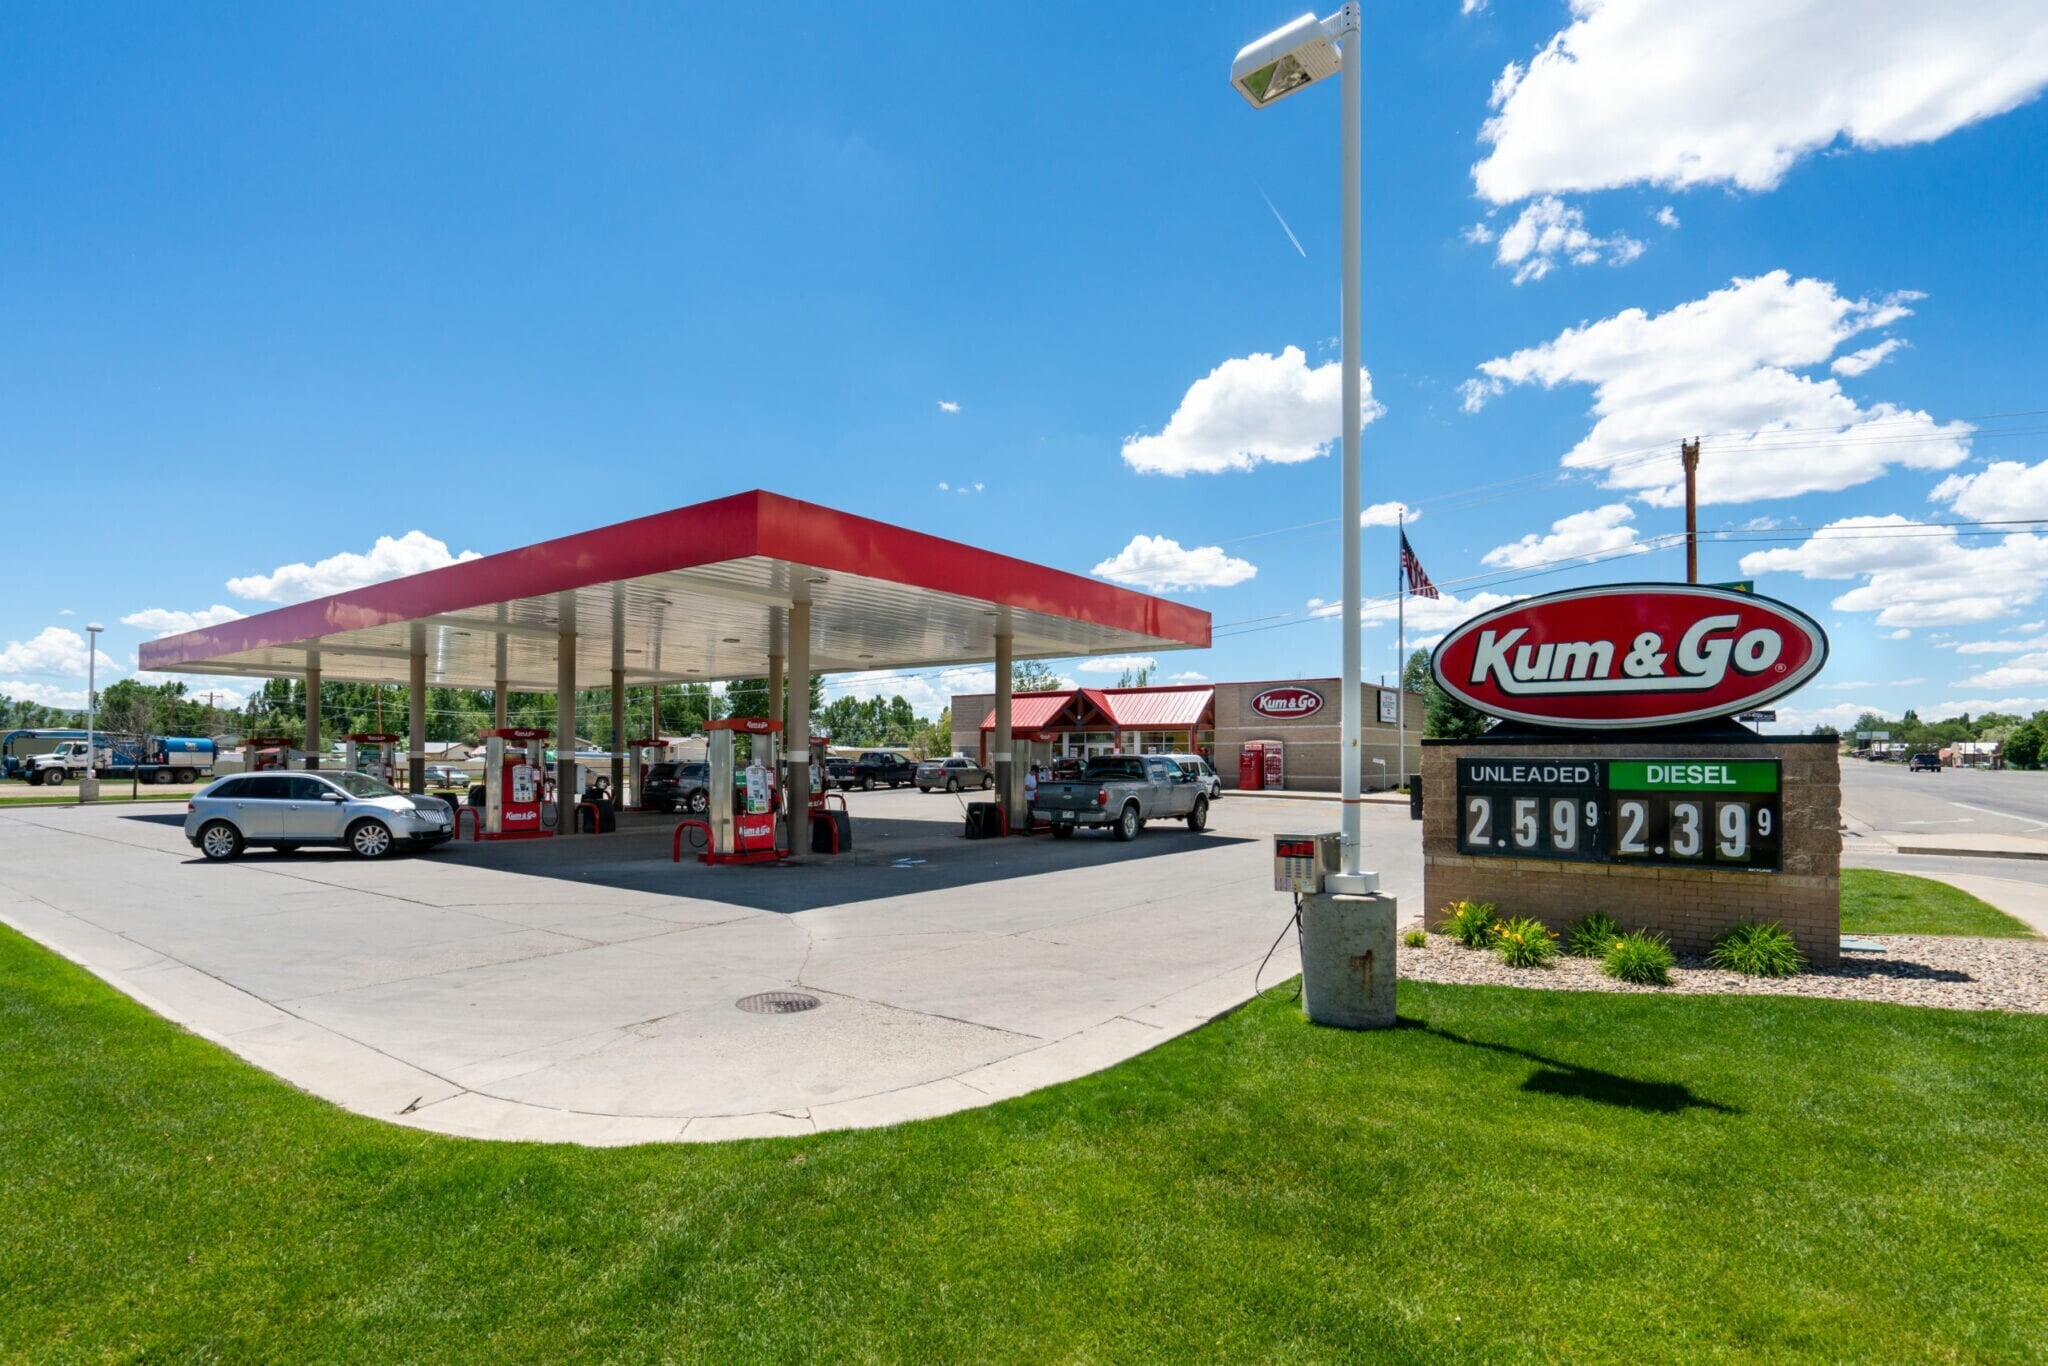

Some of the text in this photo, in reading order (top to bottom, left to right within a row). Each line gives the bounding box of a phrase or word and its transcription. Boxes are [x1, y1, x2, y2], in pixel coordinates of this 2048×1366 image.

[1470, 614, 1783, 694] Kum & Go
[1259, 694, 1316, 711] Kum & Go
[1471, 766, 1590, 783] UNLEADED
[1647, 765, 1737, 784] DIESEL
[1278, 843, 1314, 857] AIR
